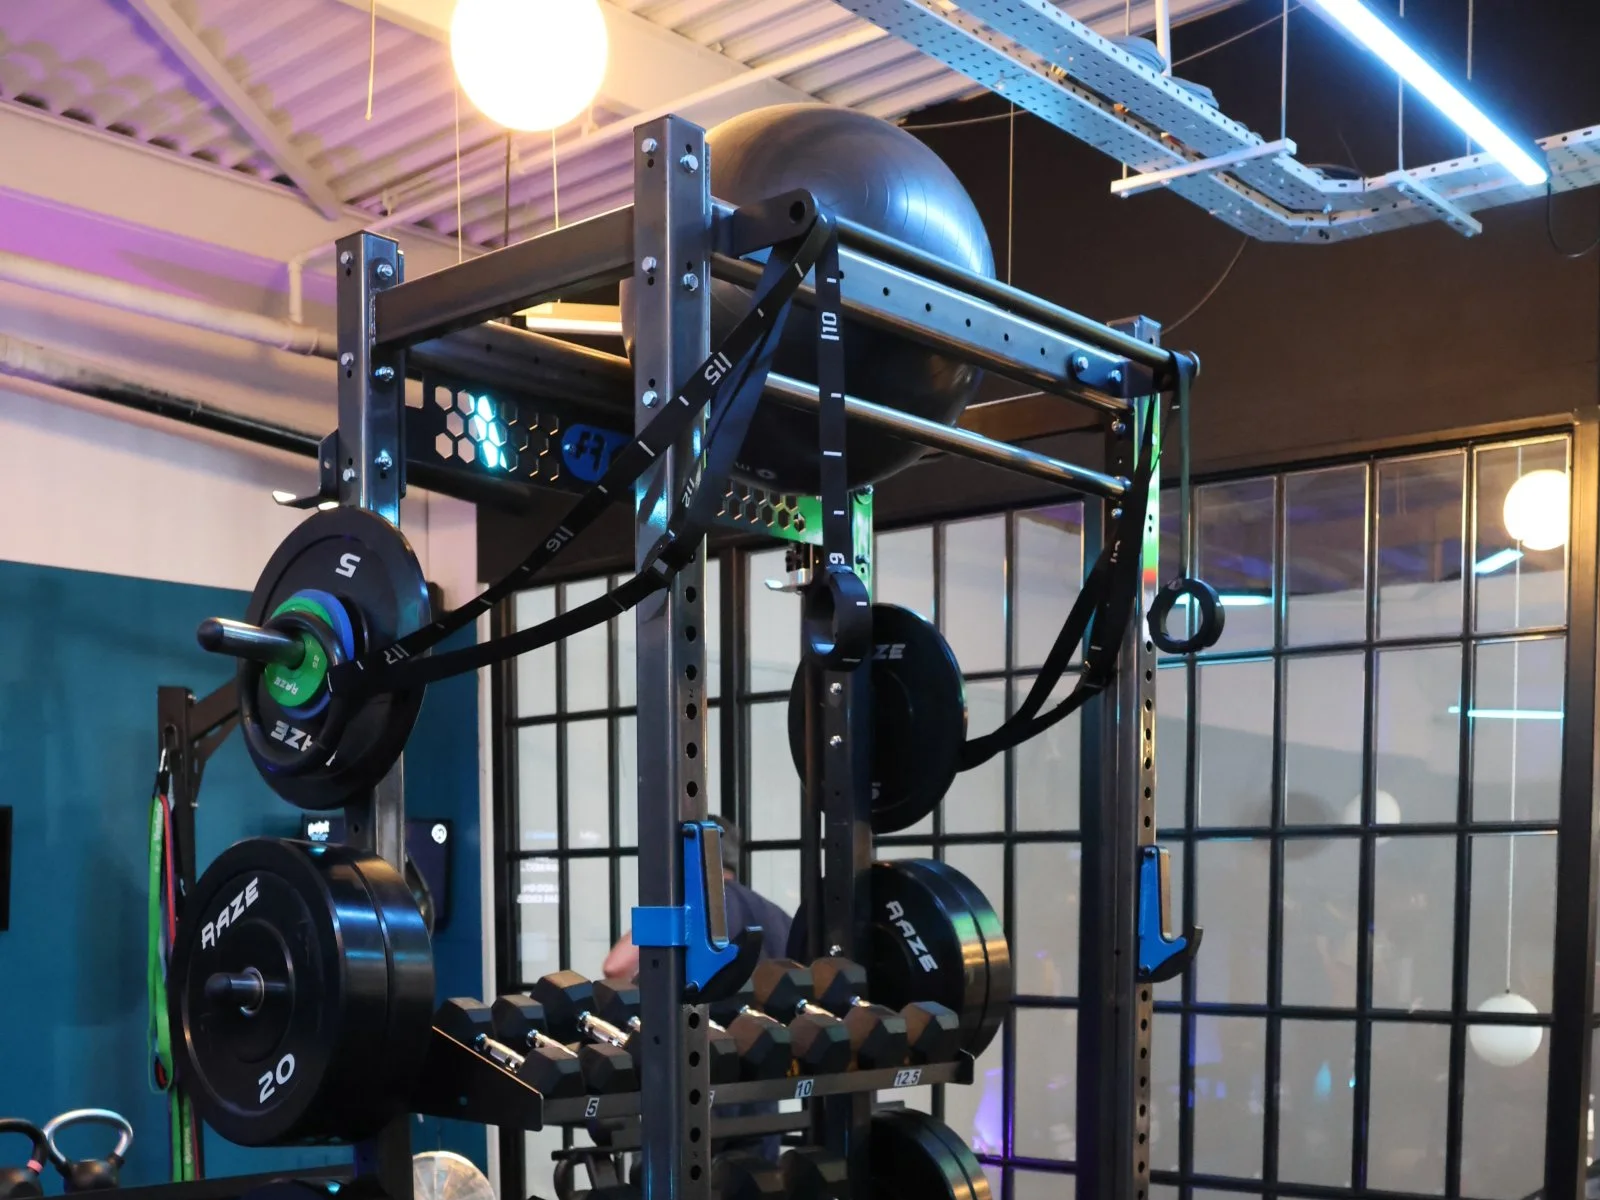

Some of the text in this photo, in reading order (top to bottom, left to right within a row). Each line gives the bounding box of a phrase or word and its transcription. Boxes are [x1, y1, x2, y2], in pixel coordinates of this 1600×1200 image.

[335, 552, 362, 579] 5
[201, 876, 259, 950] RAZE
[886, 899, 938, 973] RAZE
[258, 1053, 296, 1104] 20
[797, 1080, 811, 1096] 10
[896, 1070, 920, 1086] 12.5
[586, 1098, 599, 1117] 5
